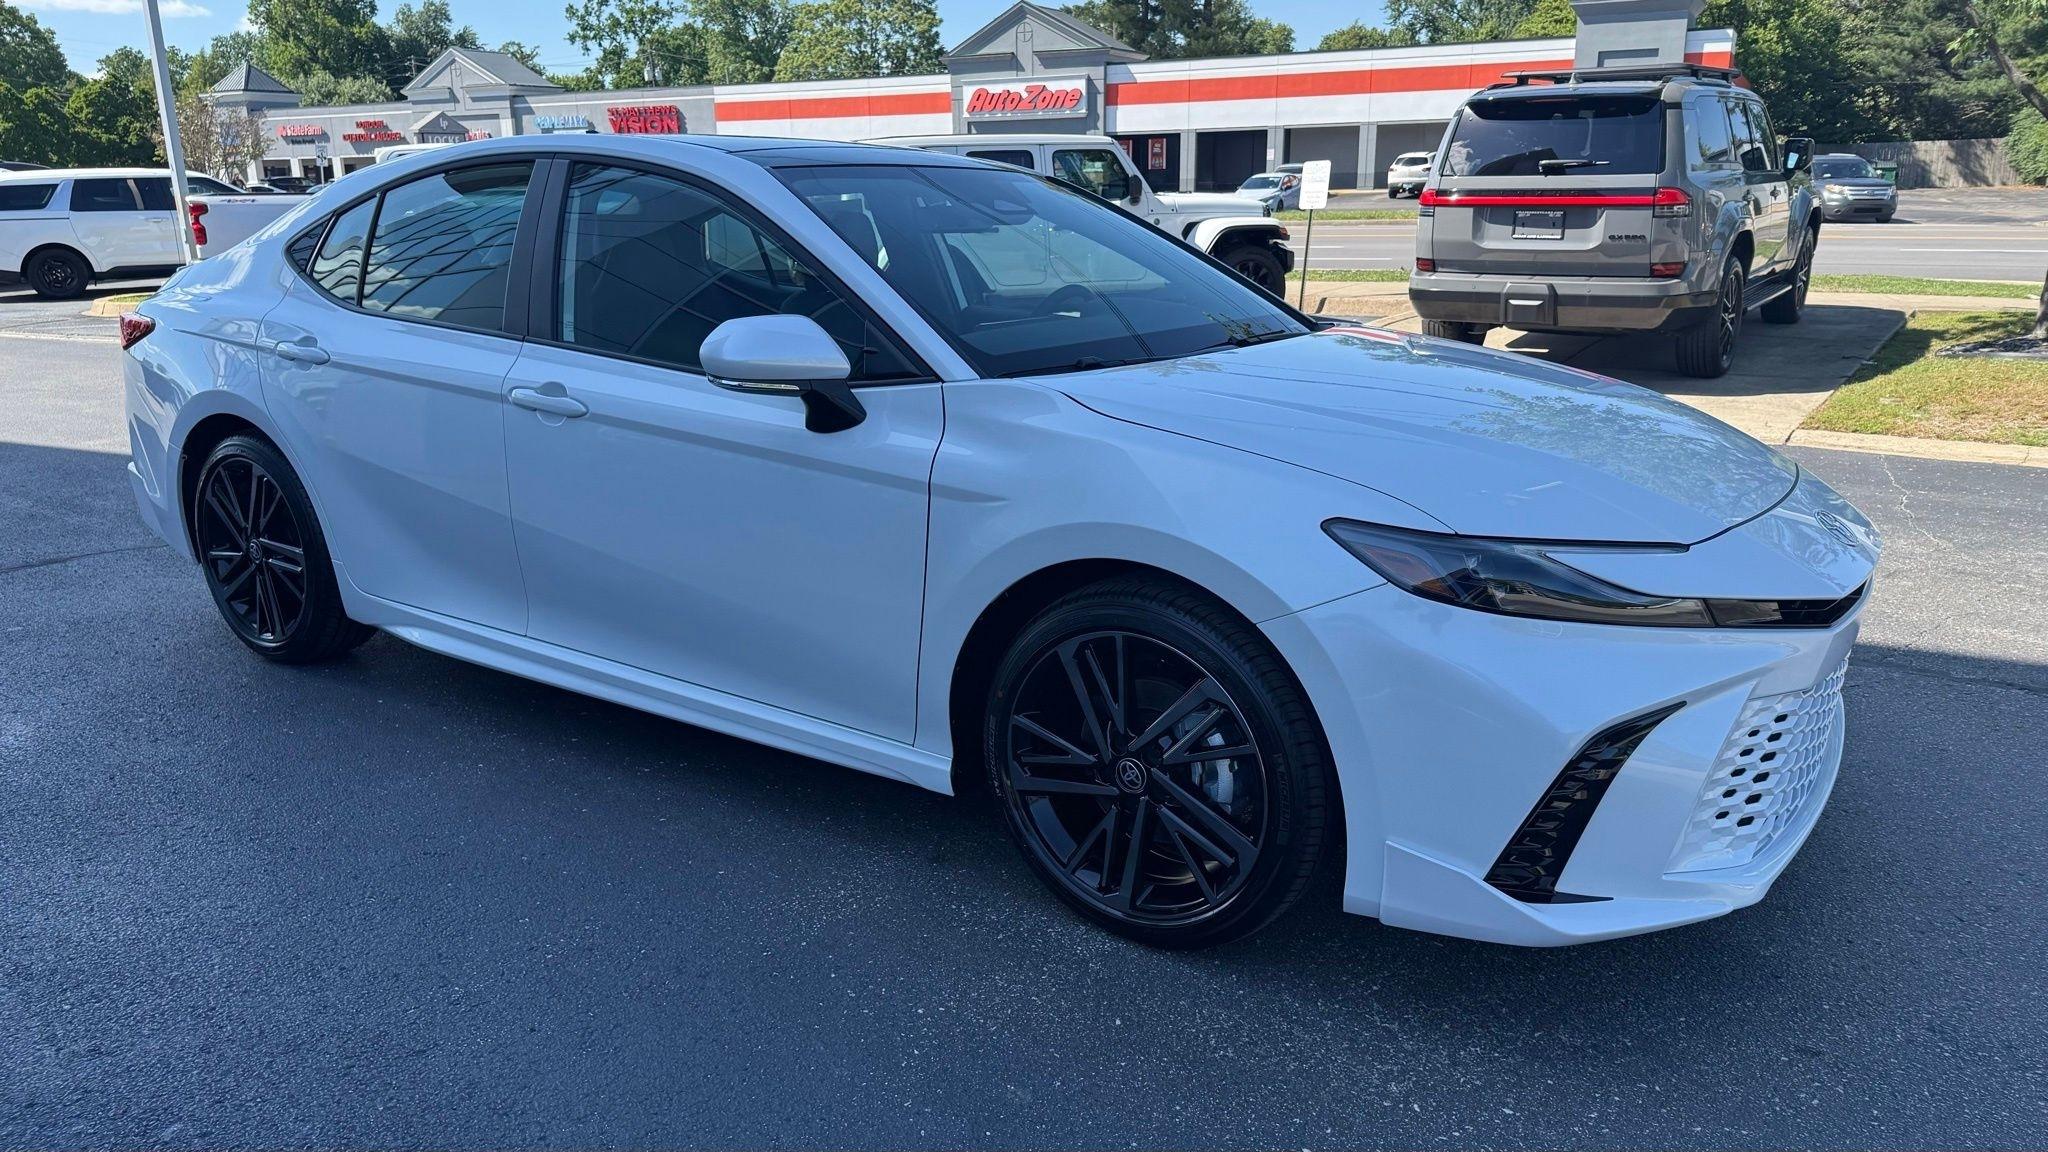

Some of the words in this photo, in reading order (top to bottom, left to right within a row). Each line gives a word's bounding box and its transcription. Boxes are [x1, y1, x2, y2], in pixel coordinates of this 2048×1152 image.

[966, 84, 1082, 112] AutoZone
[621, 105, 679, 117] MATTHEWS
[609, 114, 680, 133] VISION
